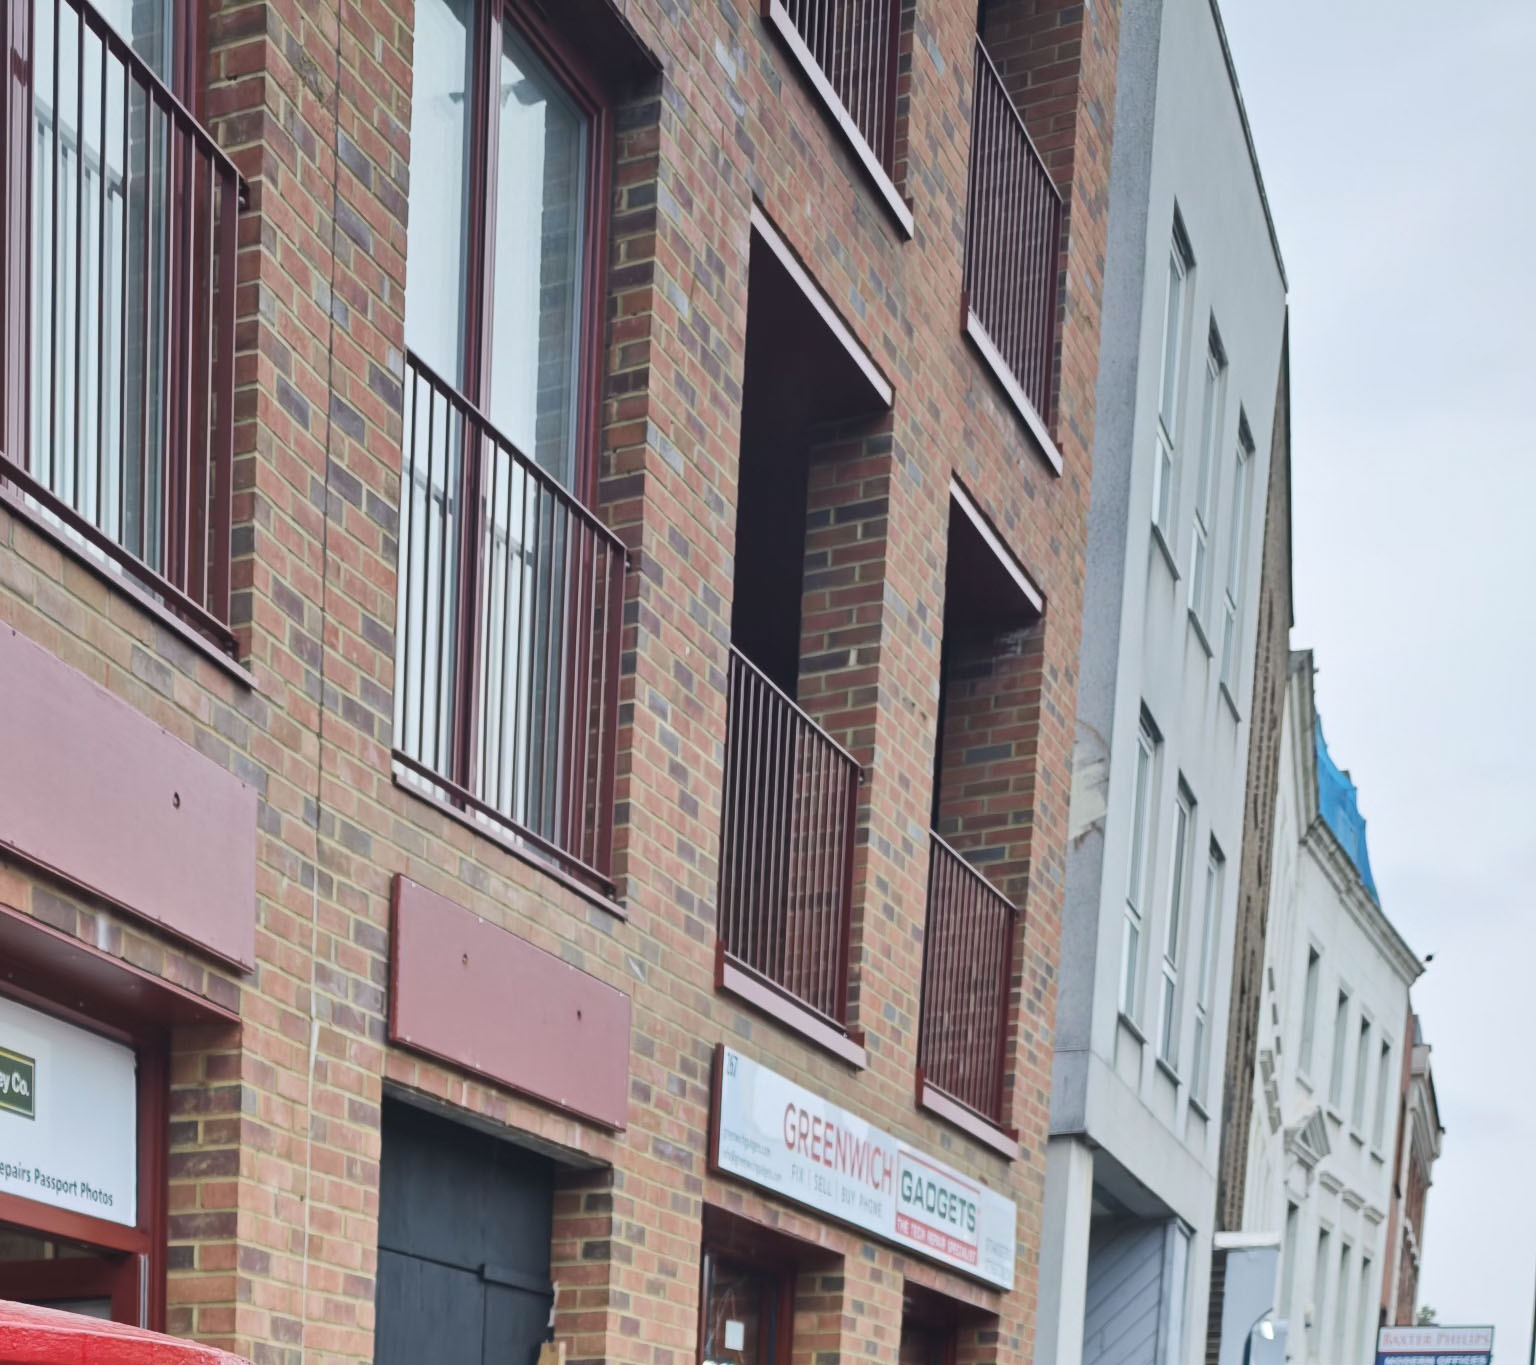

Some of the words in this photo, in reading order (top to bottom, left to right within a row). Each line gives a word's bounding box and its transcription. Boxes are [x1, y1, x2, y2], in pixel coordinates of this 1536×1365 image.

[12, 1072, 30, 1096] Co.
[784, 1102, 892, 1196] GREENWICH
[34, 1168, 77, 1197] Passport
[81, 1181, 113, 1207] Photos
[901, 1170, 976, 1232] GADGETS
